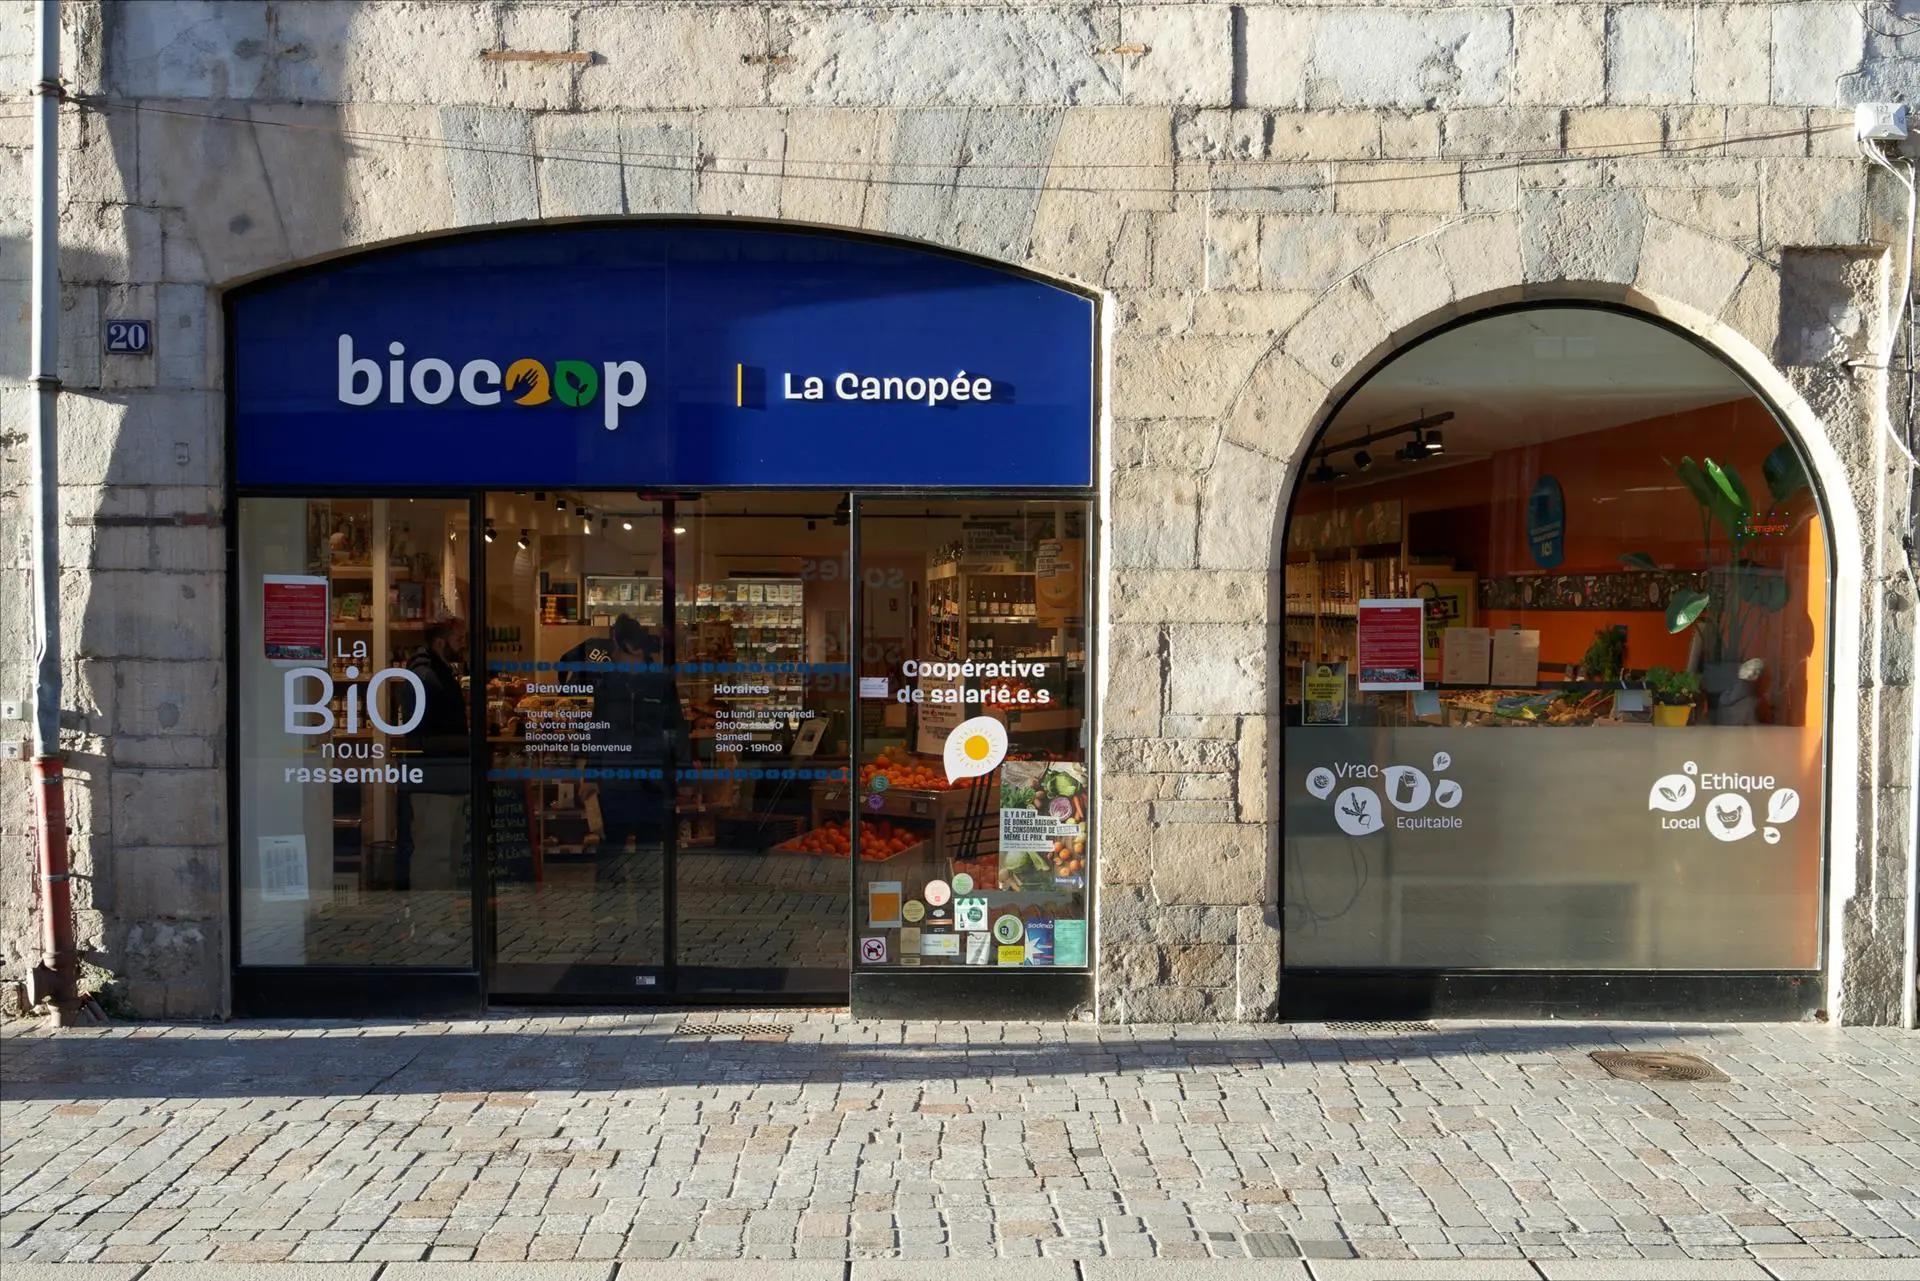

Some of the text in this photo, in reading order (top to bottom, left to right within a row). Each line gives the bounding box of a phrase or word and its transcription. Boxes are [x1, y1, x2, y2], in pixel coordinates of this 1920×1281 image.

[109, 324, 146, 349] 20
[337, 333, 648, 431] biocoop
[783, 368, 993, 407] La Canopée
[337, 637, 368, 658] La
[902, 657, 1046, 681] Coopérative
[526, 683, 594, 694] Bienvenue
[714, 684, 770, 694] Horaires
[896, 684, 925, 704] de
[930, 684, 1051, 704] salarié.e.s
[284, 665, 427, 736] BiO
[526, 710, 593, 720] Toute l'équipe
[716, 710, 815, 719] Du lundi au vendredi
[525, 721, 611, 732] de votre magasin
[716, 722, 743, 730] 9h00
[526, 732, 565, 742] Biocoop
[716, 732, 752, 742] Samedi
[321, 741, 386, 760] nous
[526, 744, 633, 752] souhaite la bienvenue
[716, 744, 743, 752] 9h00
[750, 744, 782, 752] 19h00
[284, 763, 425, 785] rassemble
[1334, 761, 1380, 780] Vrac
[1701, 772, 1776, 793] Ethique
[1396, 816, 1463, 831] Equitable
[1662, 816, 1700, 831] Local
[1004, 832, 1021, 840] MÊME
